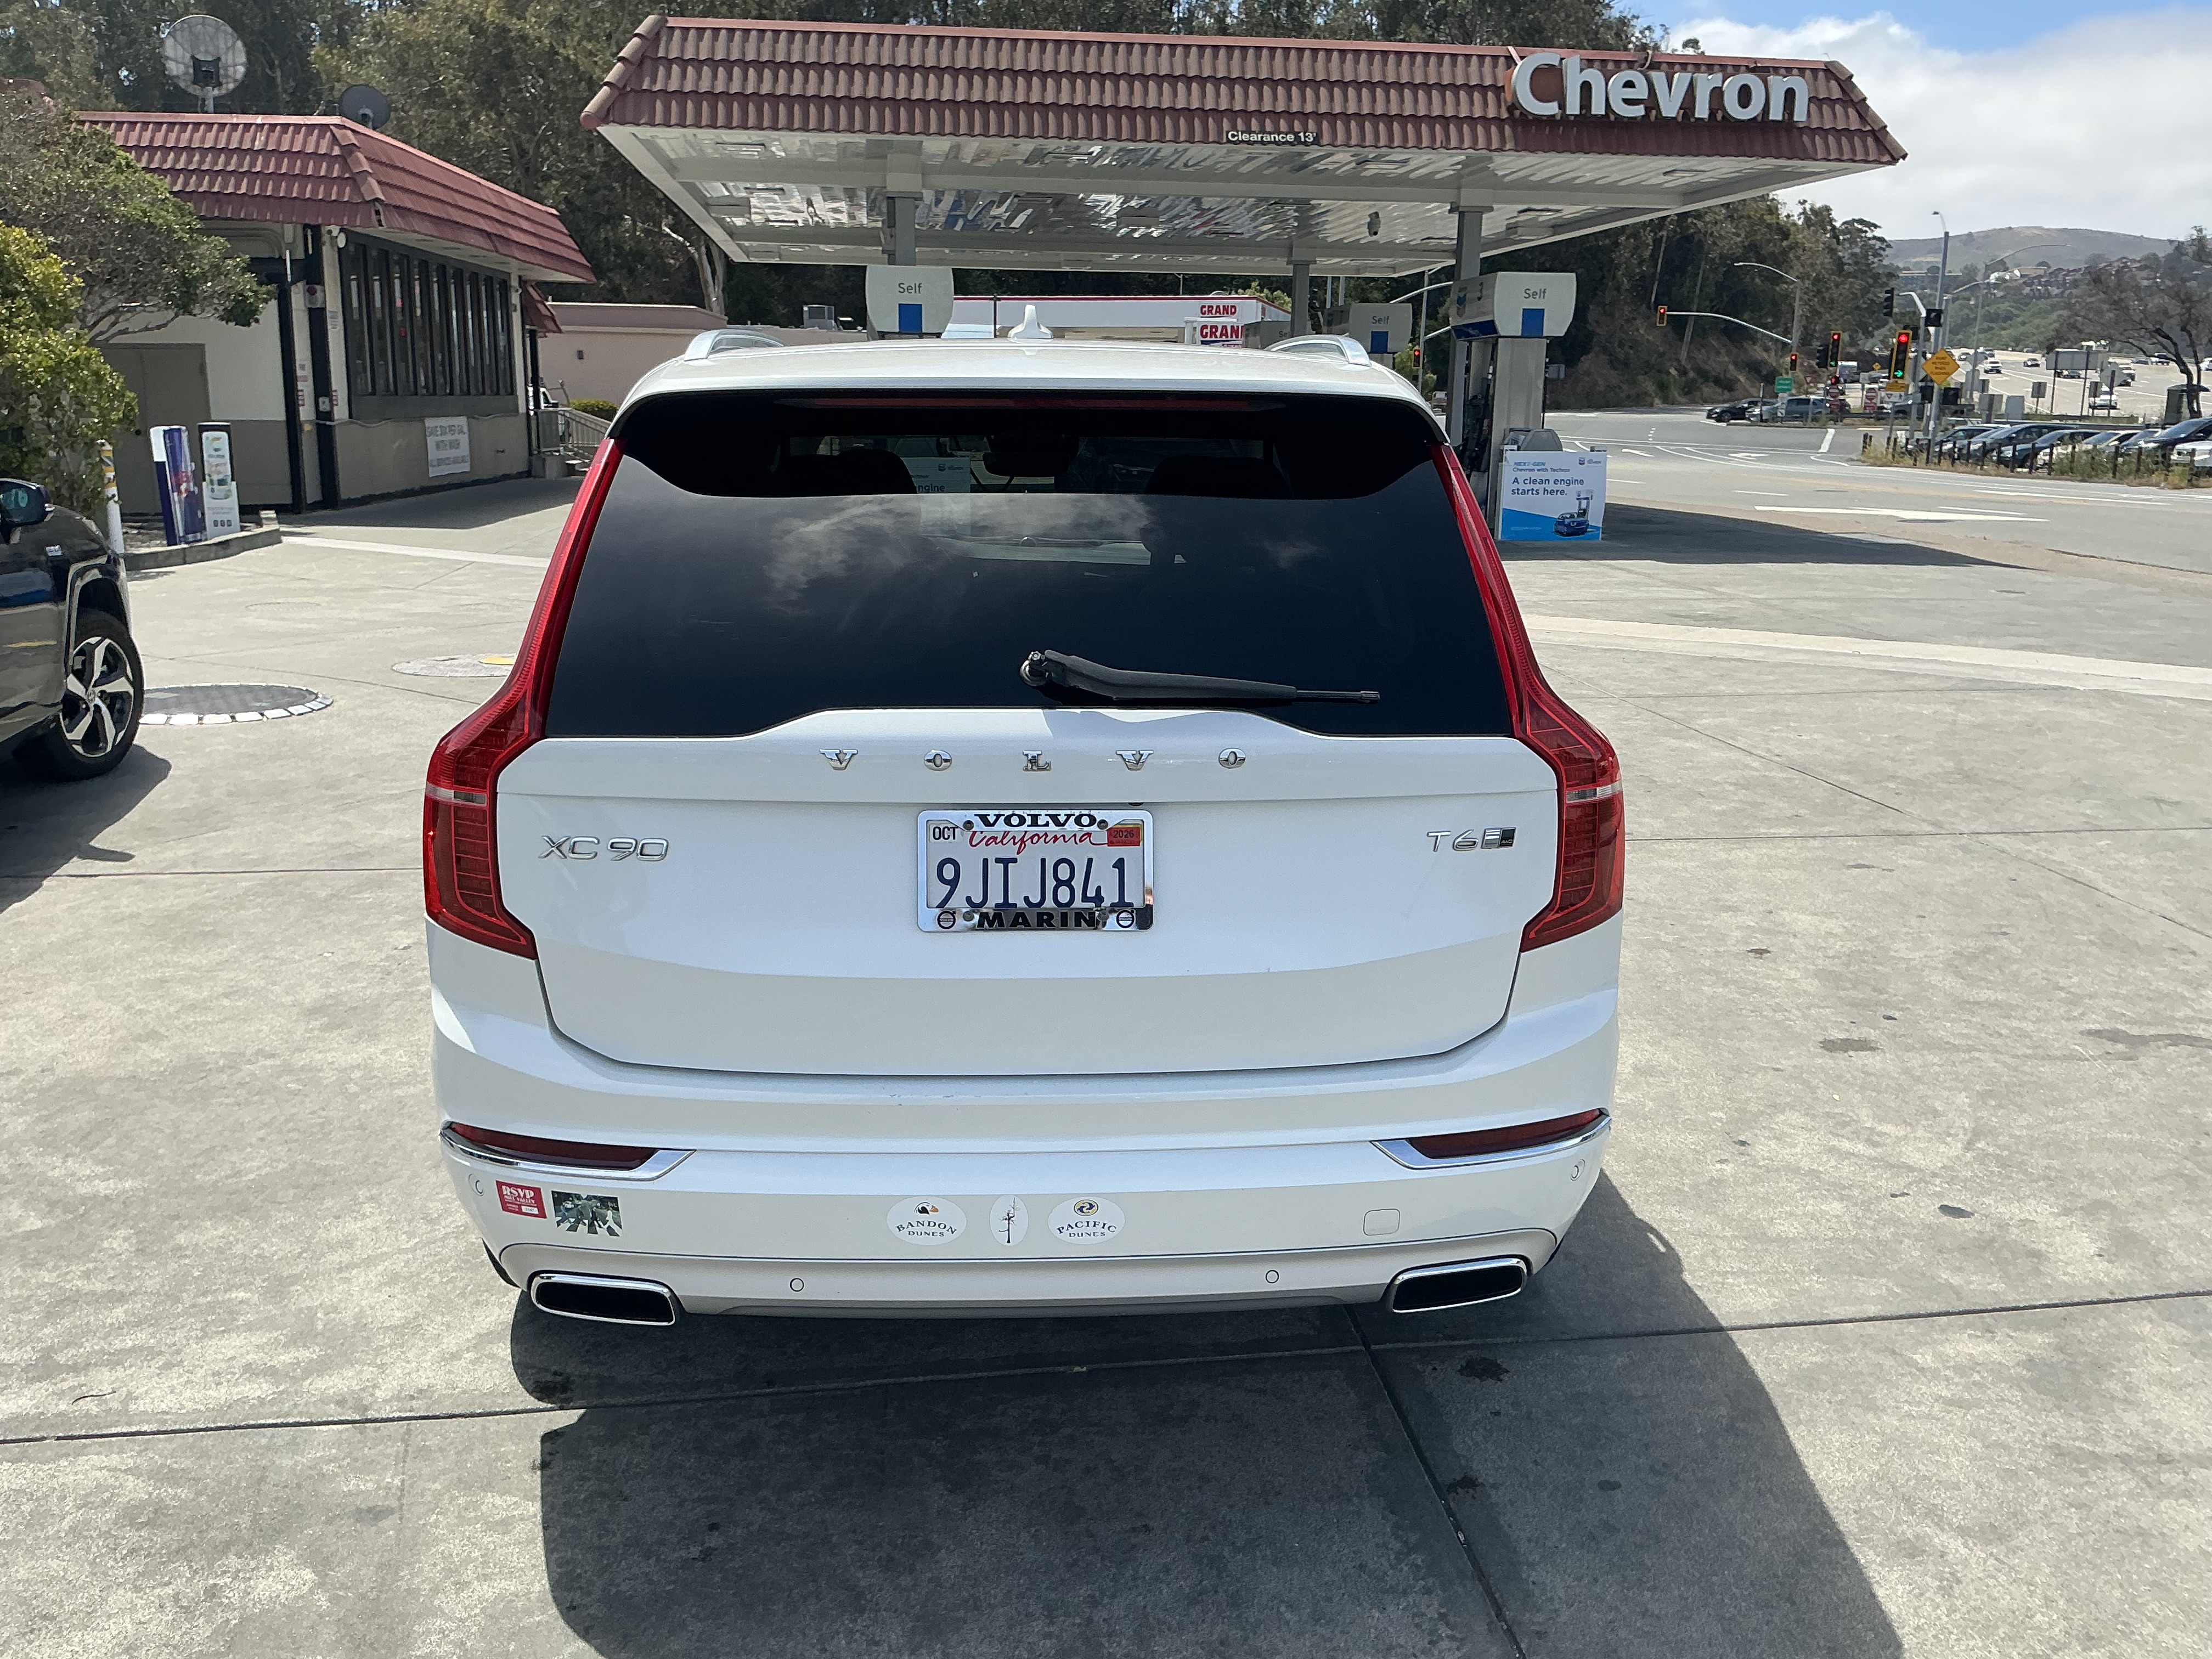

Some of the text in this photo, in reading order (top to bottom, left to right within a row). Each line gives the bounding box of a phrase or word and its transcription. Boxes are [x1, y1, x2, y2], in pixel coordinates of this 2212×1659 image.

[1511, 52, 1809, 122] Chevron
[1228, 131, 1316, 142] Clearance 13'
[898, 283, 922, 294] Self
[1523, 288, 1547, 300] Self
[1200, 304, 1237, 315] GRAND
[1372, 315, 1389, 324] Self
[918, 484, 945, 493] ngine
[1512, 477, 1584, 487] A clean engine
[819, 747, 1247, 772] VOLVO
[974, 814, 1096, 827] VOLVO
[933, 826, 958, 840] OCT
[1113, 829, 1135, 838] 2026
[969, 830, 1107, 855] California
[1426, 829, 1479, 852] T6
[935, 857, 1134, 909] 9JIJ841
[977, 911, 1097, 928] MARIN
[502, 1185, 534, 1199] RSVP
[895, 1220, 957, 1235] BANDON
[1057, 1220, 1117, 1234] PACIFIC
